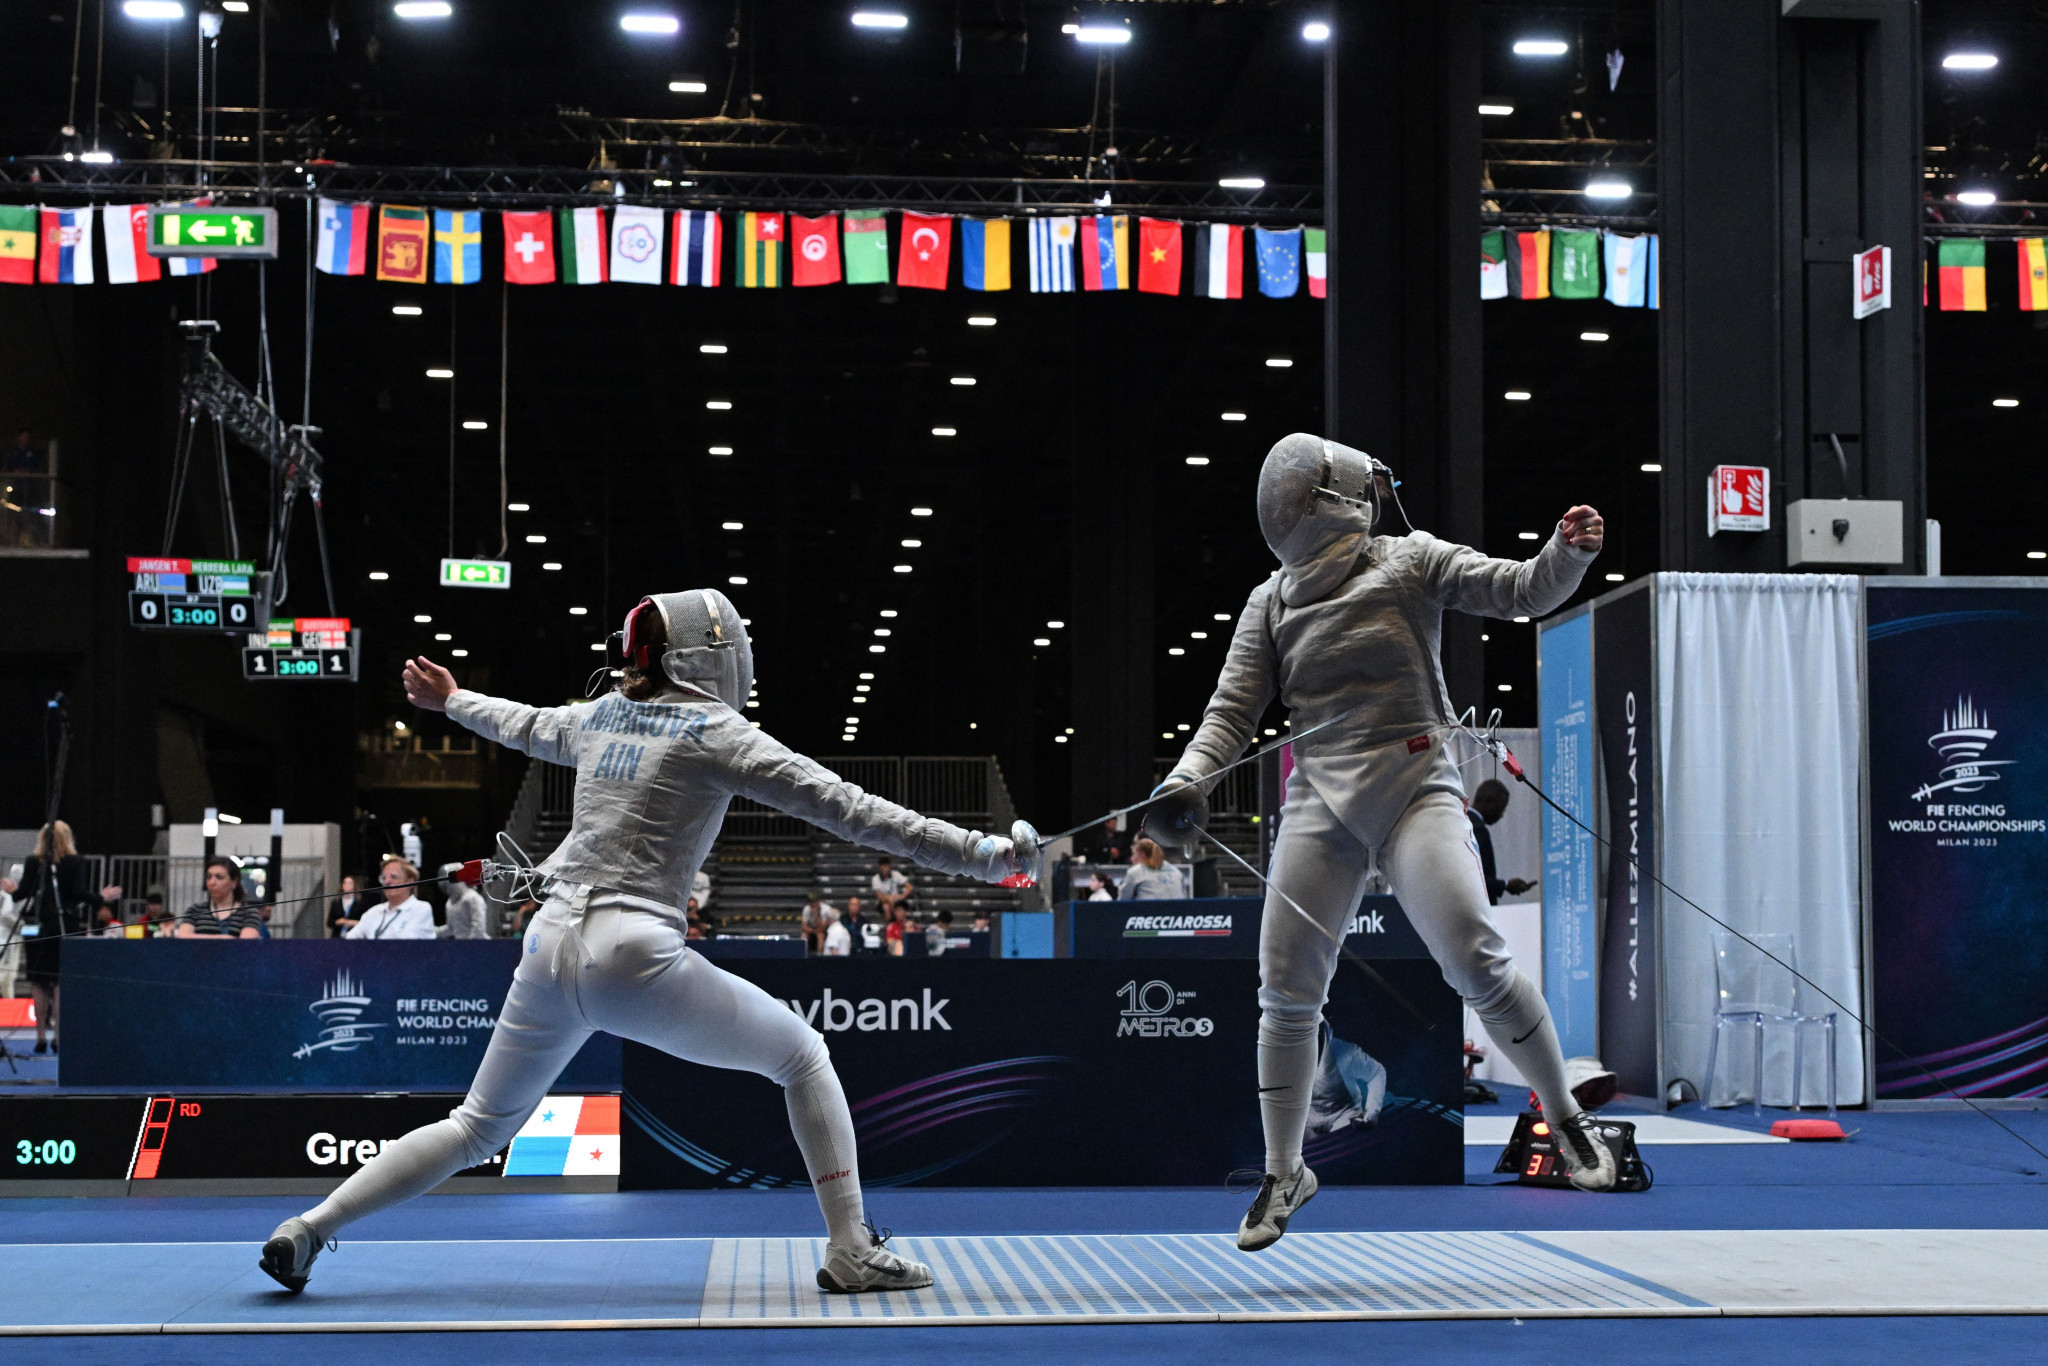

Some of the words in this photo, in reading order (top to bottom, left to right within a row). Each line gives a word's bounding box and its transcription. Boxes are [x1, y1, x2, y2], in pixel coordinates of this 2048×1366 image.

[135, 573, 158, 592] ARU
[141, 600, 157, 620] 0
[171, 608, 217, 625] 3:00
[230, 603, 247, 623] 0
[254, 655, 267, 672] 1
[279, 660, 318, 675] 3:00
[330, 655, 343, 672] 1
[594, 742, 645, 781] AIN
[1955, 766, 1979, 779] 2023
[1926, 804, 1945, 816] FIE
[1948, 804, 2006, 816] FENCING
[1888, 820, 1936, 832] WORLD
[1938, 820, 2046, 832] CHAMPIONSHIPS
[1625, 691, 1638, 1000] #ALLEZMILANO
[1937, 838, 1970, 846] MILAN
[1973, 838, 1998, 846] 2023
[1125, 915, 1232, 929] FRECCIAROSSA
[396, 999, 417, 1012] FIE
[421, 999, 489, 1012] FENCING
[1116, 980, 1174, 1016] 10
[774, 988, 952, 1031] ybank
[397, 1016, 453, 1029] WORLD
[396, 1036, 435, 1045] MILAN
[439, 1036, 468, 1045] 2023
[180, 1103, 201, 1117] RD
[16, 1139, 76, 1164] 3:00
[816, 1169, 851, 1184] allstar
